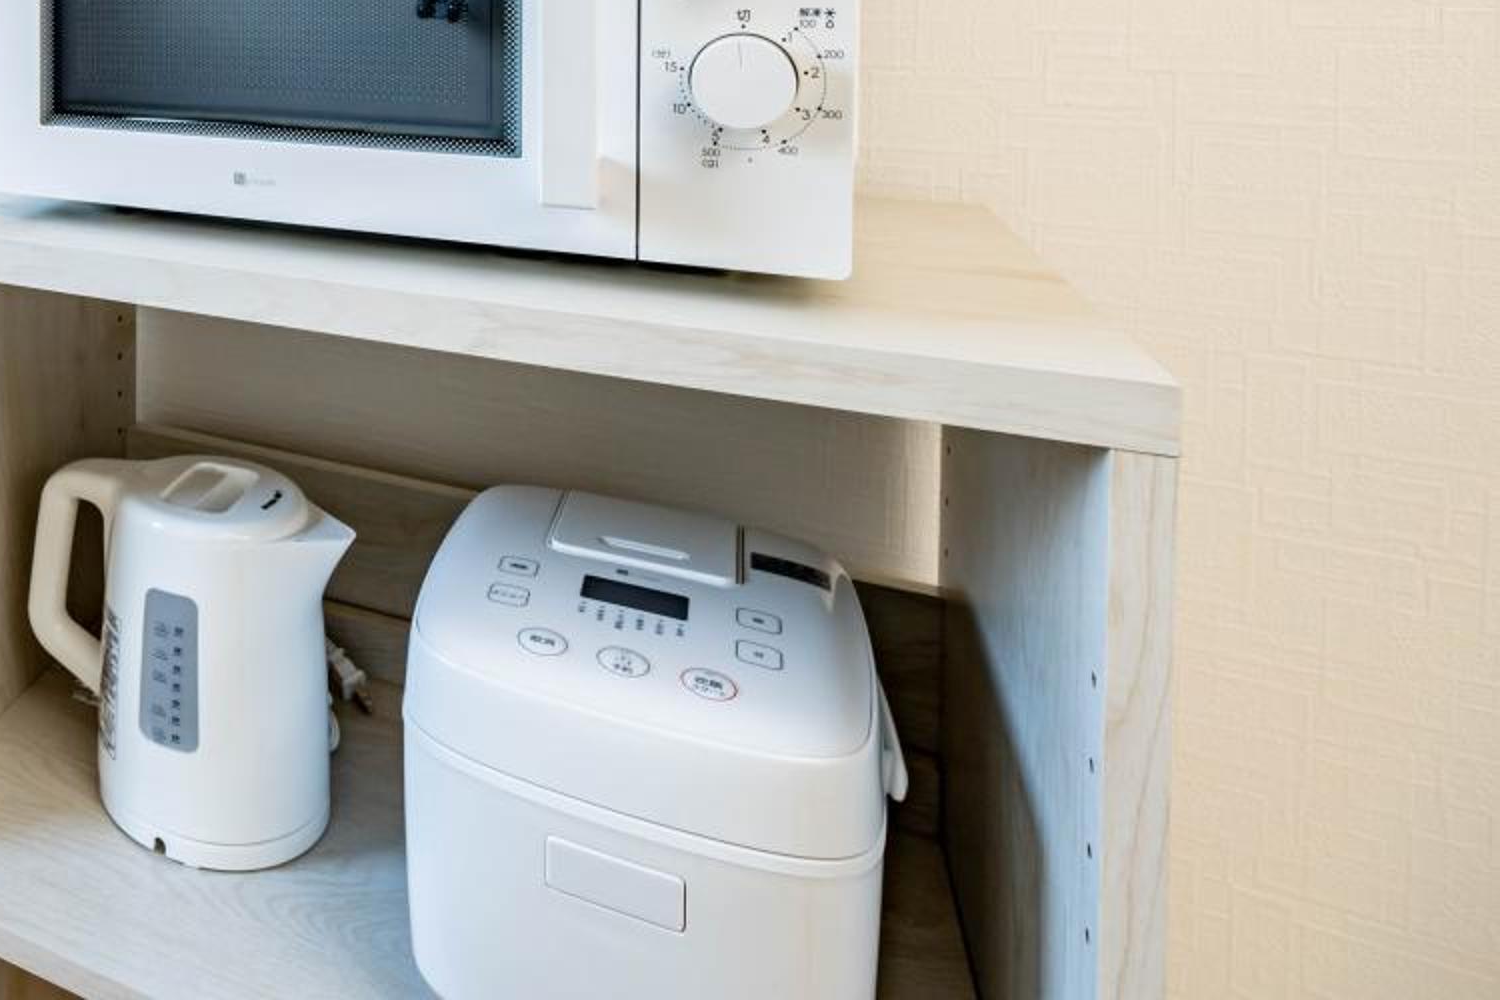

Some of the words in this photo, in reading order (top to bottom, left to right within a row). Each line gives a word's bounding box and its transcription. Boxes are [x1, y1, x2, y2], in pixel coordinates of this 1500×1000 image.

[823, 49, 844, 59] 200
[664, 61, 678, 72] 15
[810, 67, 820, 79] 2
[672, 103, 687, 114] 10
[801, 109, 811, 121] 3
[761, 134, 771, 144] 4
